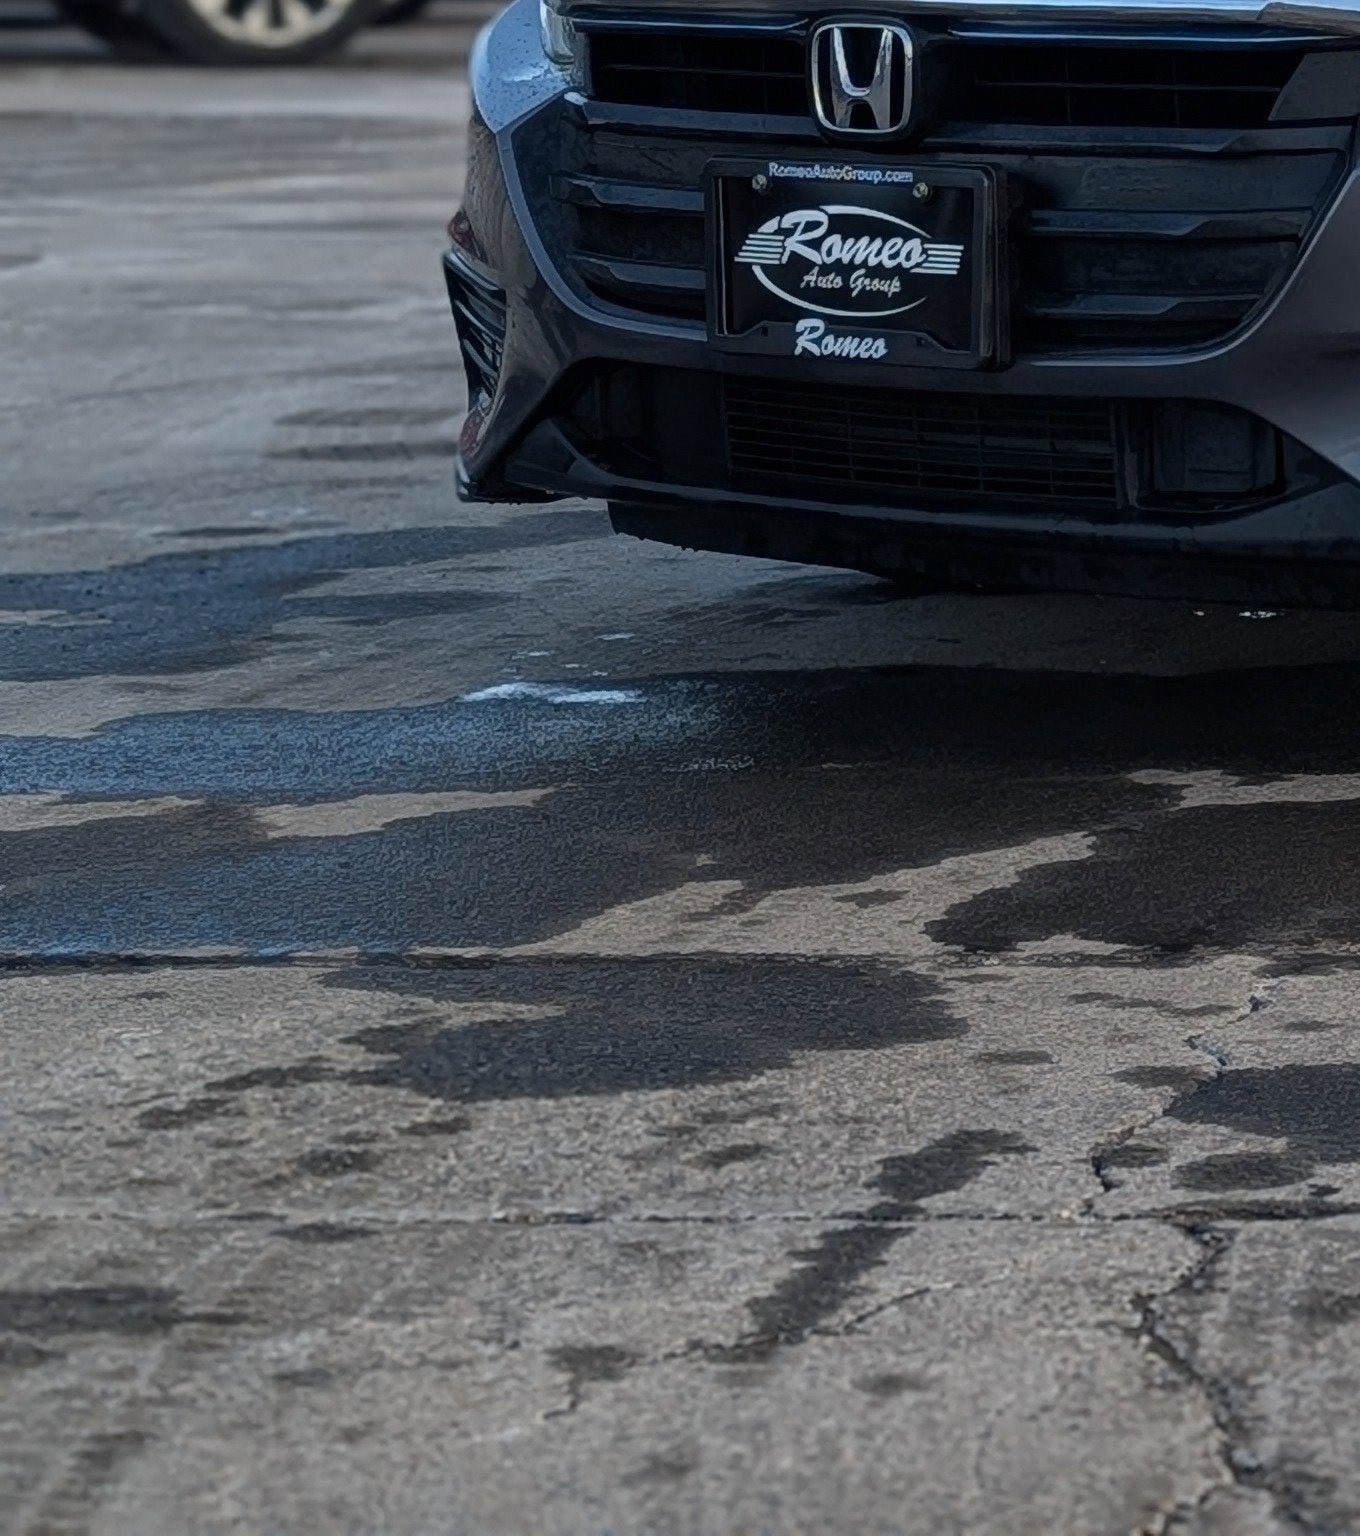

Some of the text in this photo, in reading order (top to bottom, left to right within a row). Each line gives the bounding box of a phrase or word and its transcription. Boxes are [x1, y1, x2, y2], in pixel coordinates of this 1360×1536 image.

[768, 162, 914, 184] RomeoAutoGroup.com
[781, 209, 928, 269] Romeo
[800, 265, 903, 298] Auto Group
[793, 318, 889, 359] Romeo
